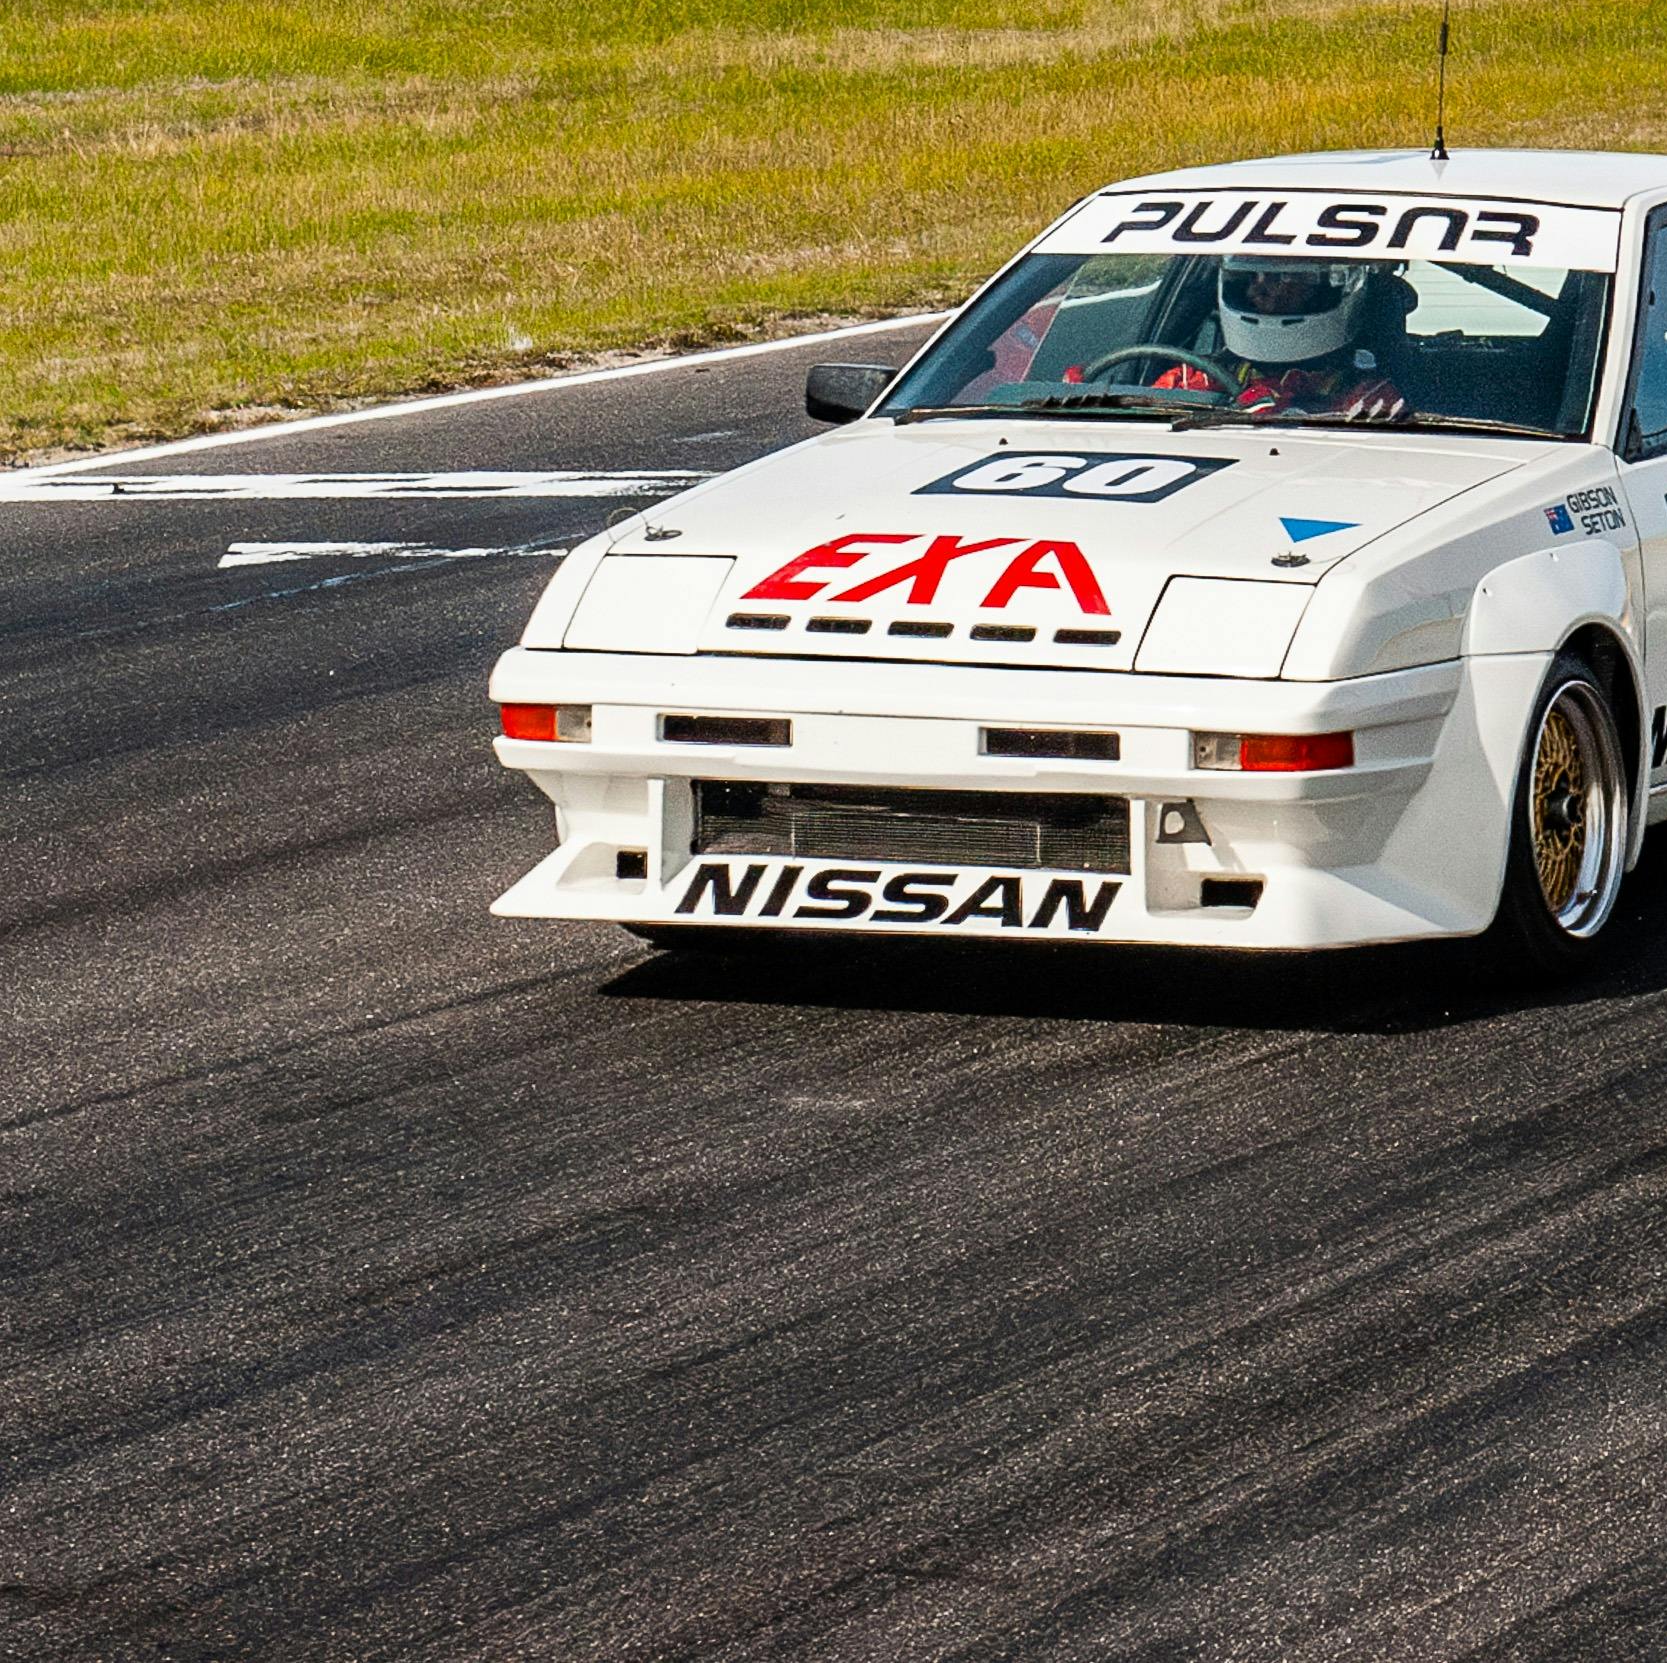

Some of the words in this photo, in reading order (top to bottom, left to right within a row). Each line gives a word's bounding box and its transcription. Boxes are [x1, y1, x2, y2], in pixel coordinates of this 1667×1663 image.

[1099, 199, 1541, 257] PULSAR
[970, 453, 1180, 503] 60
[1566, 486, 1618, 514] GIBSON
[1580, 507, 1627, 536] SETON
[740, 533, 1113, 617] EXA
[674, 862, 1124, 933] NISSAN
